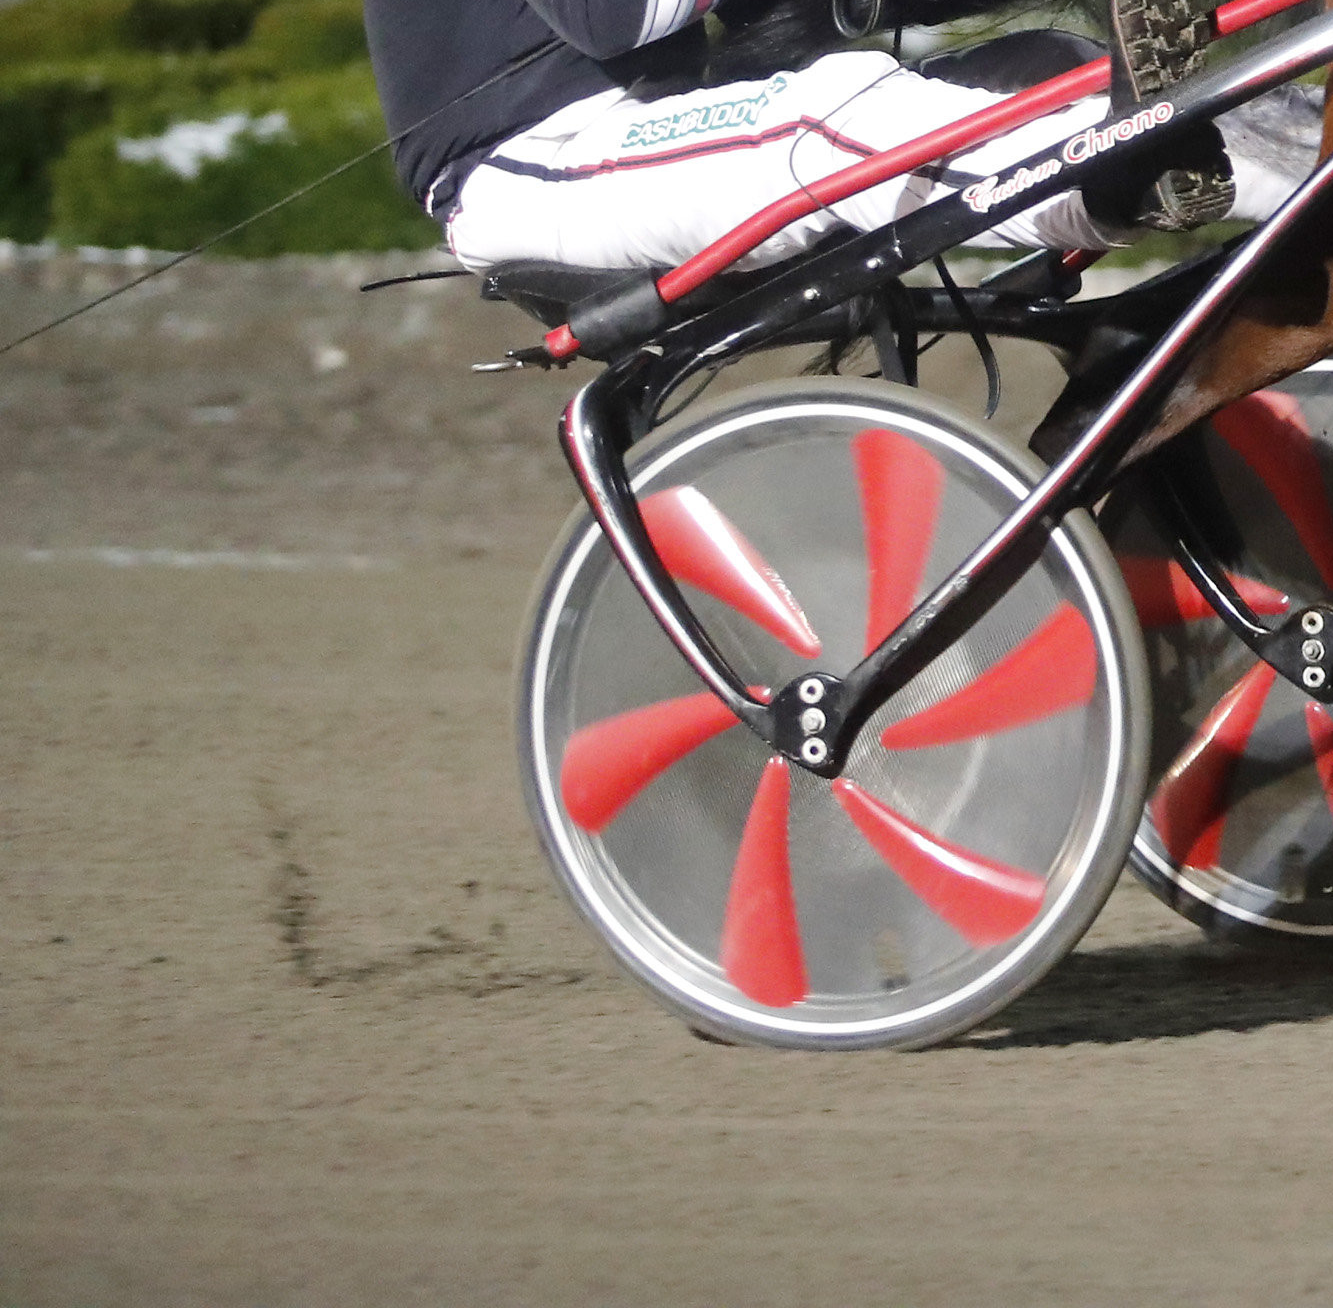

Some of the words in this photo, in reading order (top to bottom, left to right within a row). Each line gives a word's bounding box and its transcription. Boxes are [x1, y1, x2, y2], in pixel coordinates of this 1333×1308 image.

[621, 92, 770, 148] CASHBUDDY
[961, 159, 1063, 213] Custom
[1062, 101, 1174, 165] Chrono
